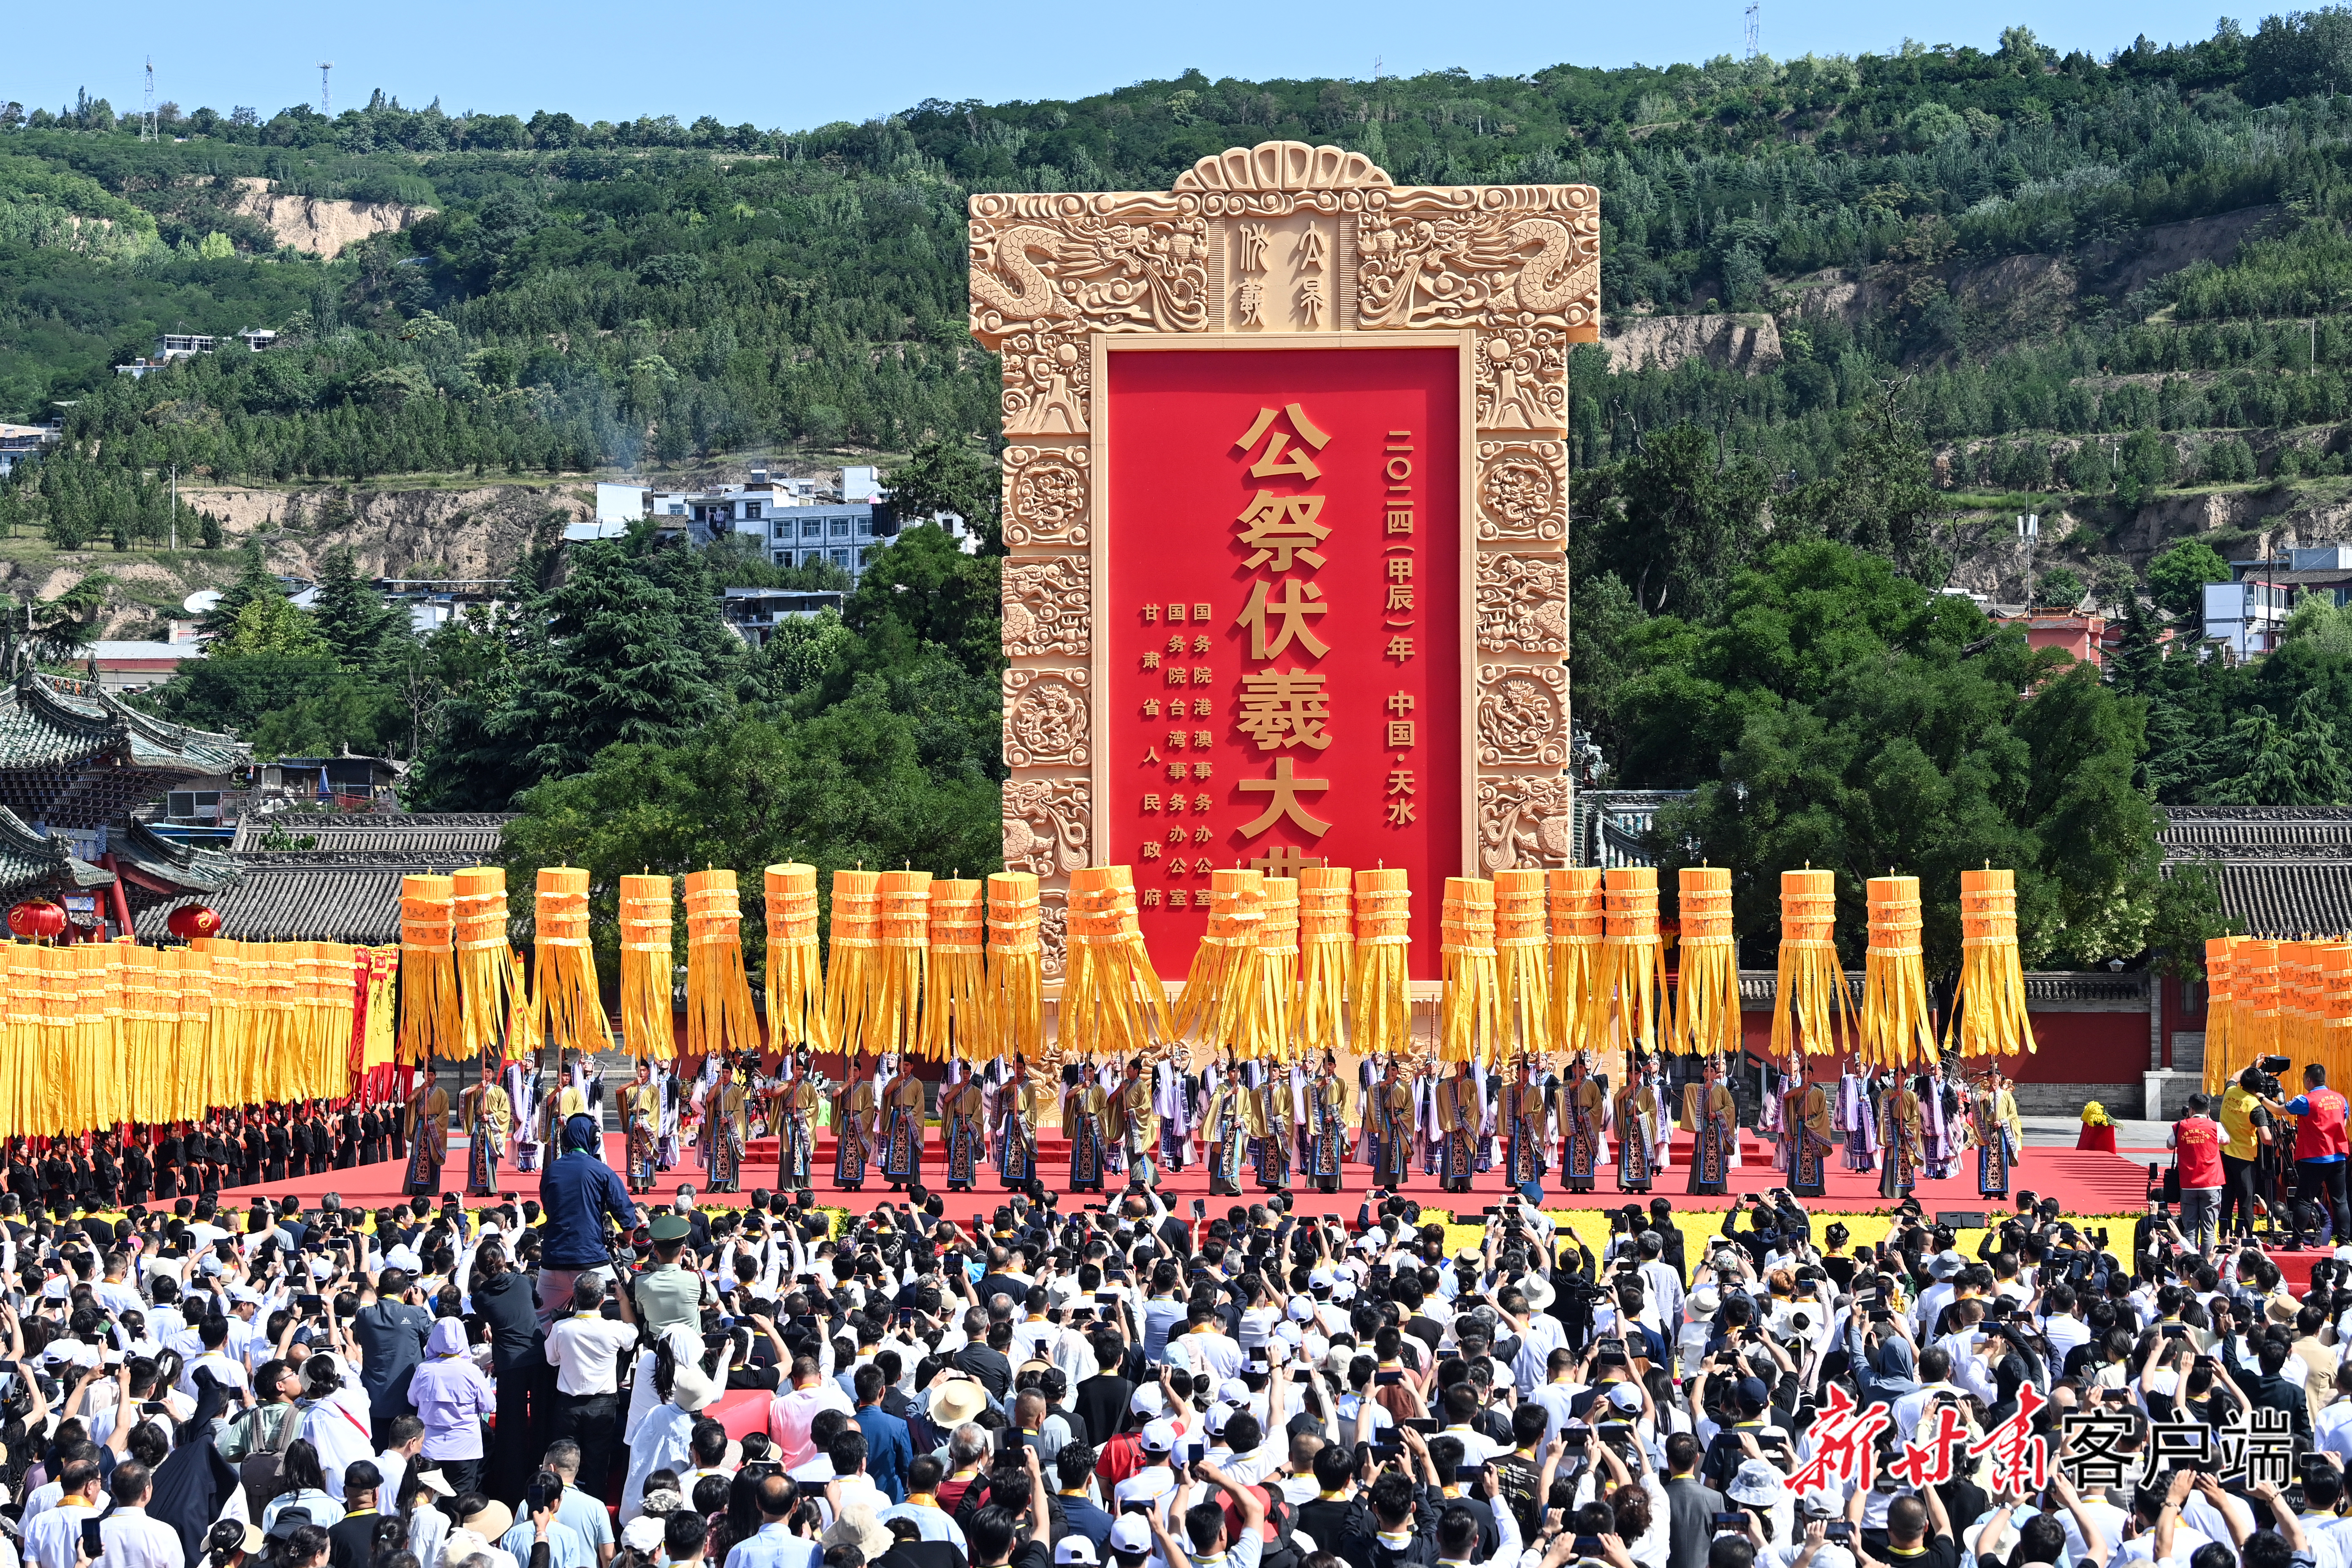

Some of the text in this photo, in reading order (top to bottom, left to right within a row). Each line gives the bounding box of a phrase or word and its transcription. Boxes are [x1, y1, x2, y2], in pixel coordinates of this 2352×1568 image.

[1142, 604, 1162, 906] 甘肃省人民政府
[1168, 604, 1187, 906] 国务院台湾事务办公室
[1194, 604, 1213, 906] 国务院港澳事务办公室
